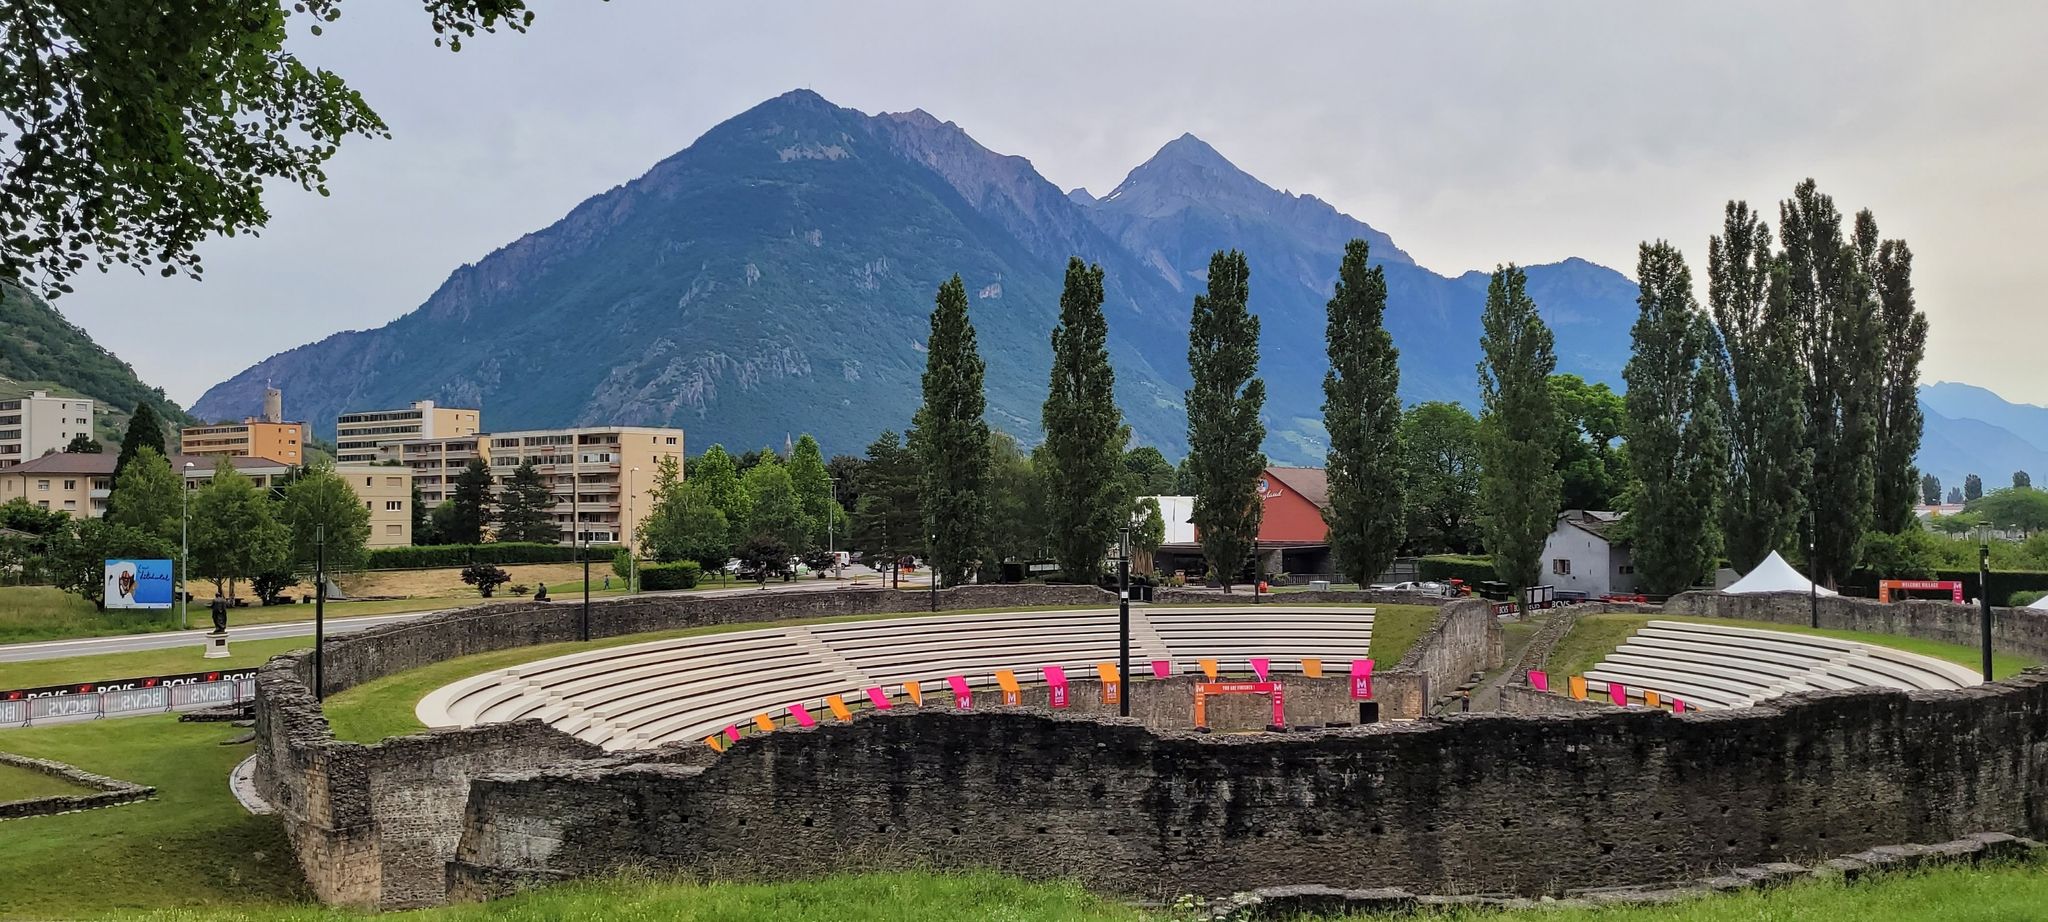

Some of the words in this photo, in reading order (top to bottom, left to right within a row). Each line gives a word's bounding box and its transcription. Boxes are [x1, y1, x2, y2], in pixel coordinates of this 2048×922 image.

[1107, 683, 1116, 693] M
[1357, 678, 1366, 688] M
[1008, 692, 1016, 702] M
[1055, 687, 1063, 697] M
[961, 697, 969, 708] M
